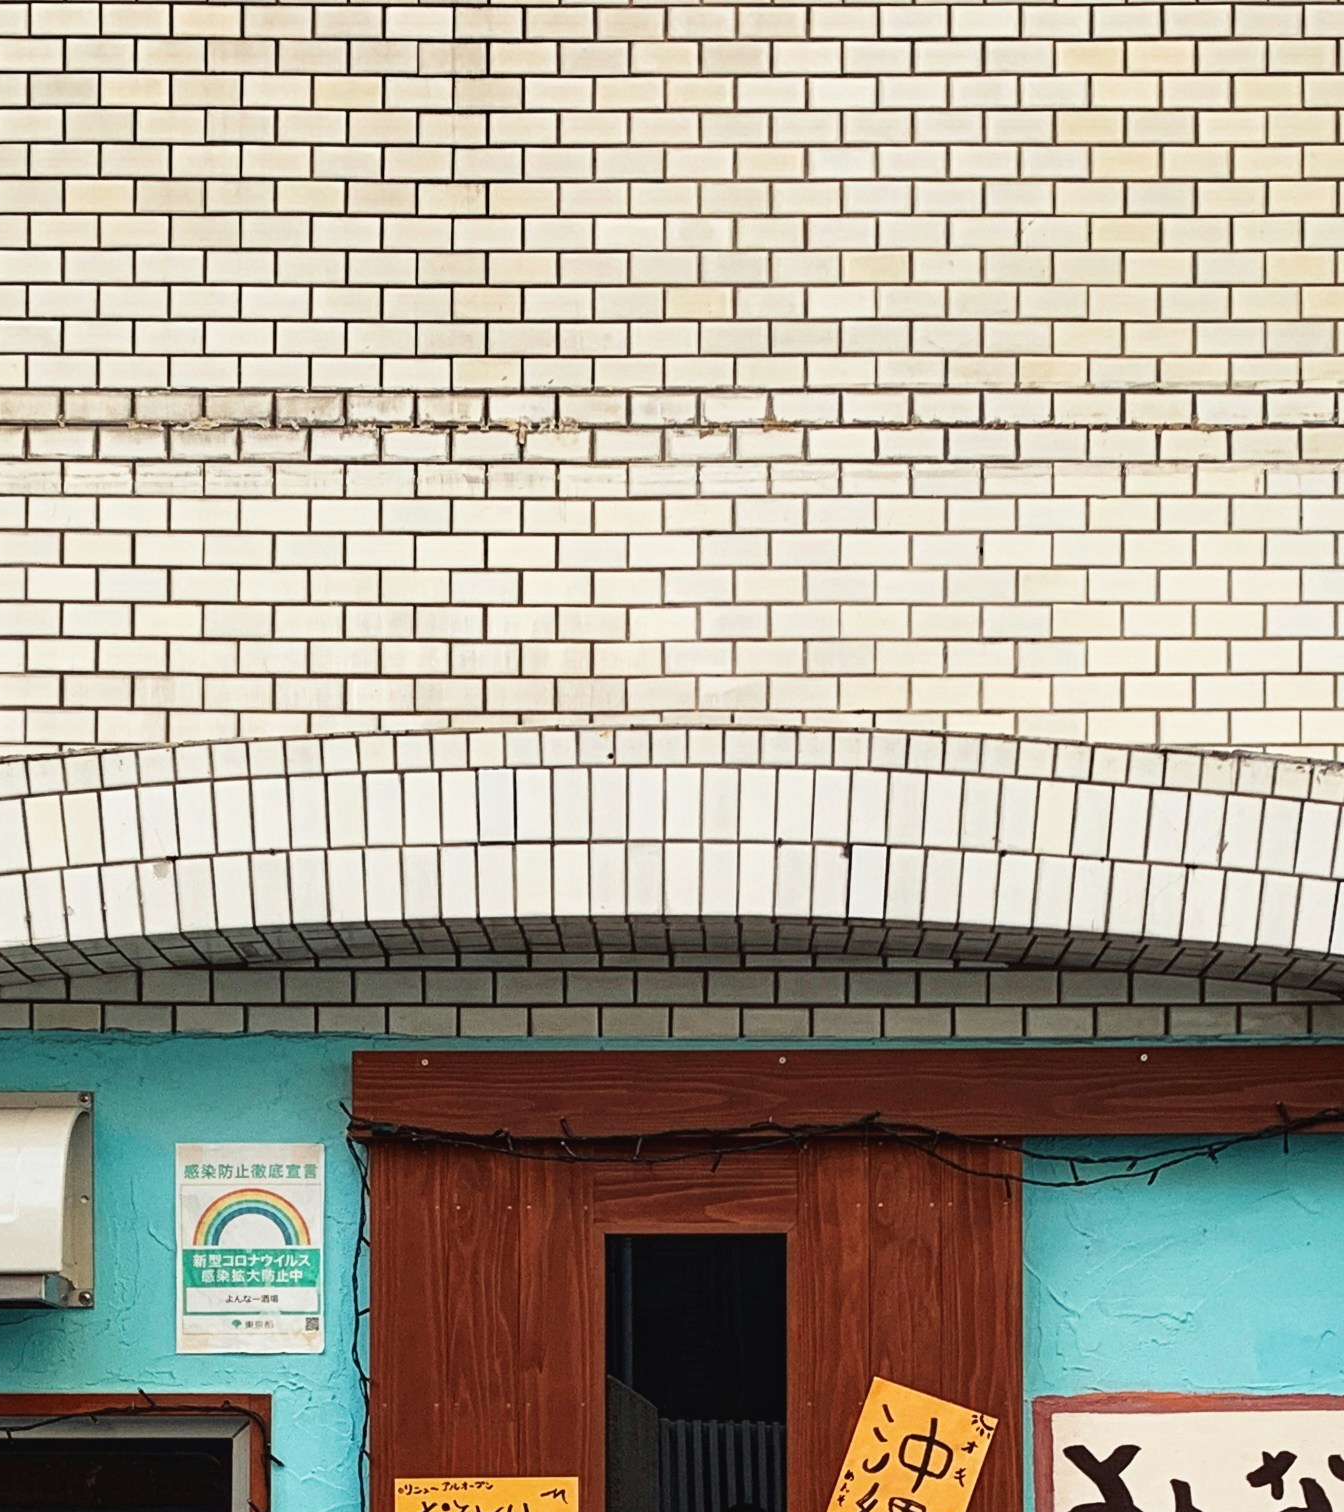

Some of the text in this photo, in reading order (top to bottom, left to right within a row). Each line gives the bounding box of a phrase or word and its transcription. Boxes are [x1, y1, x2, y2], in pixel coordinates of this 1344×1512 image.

[184, 1164, 317, 1179] 感染防止徹底宣言
[193, 1254, 311, 1267] 新型コロナウイルス
[202, 1269, 303, 1282] 感染拡大防止中
